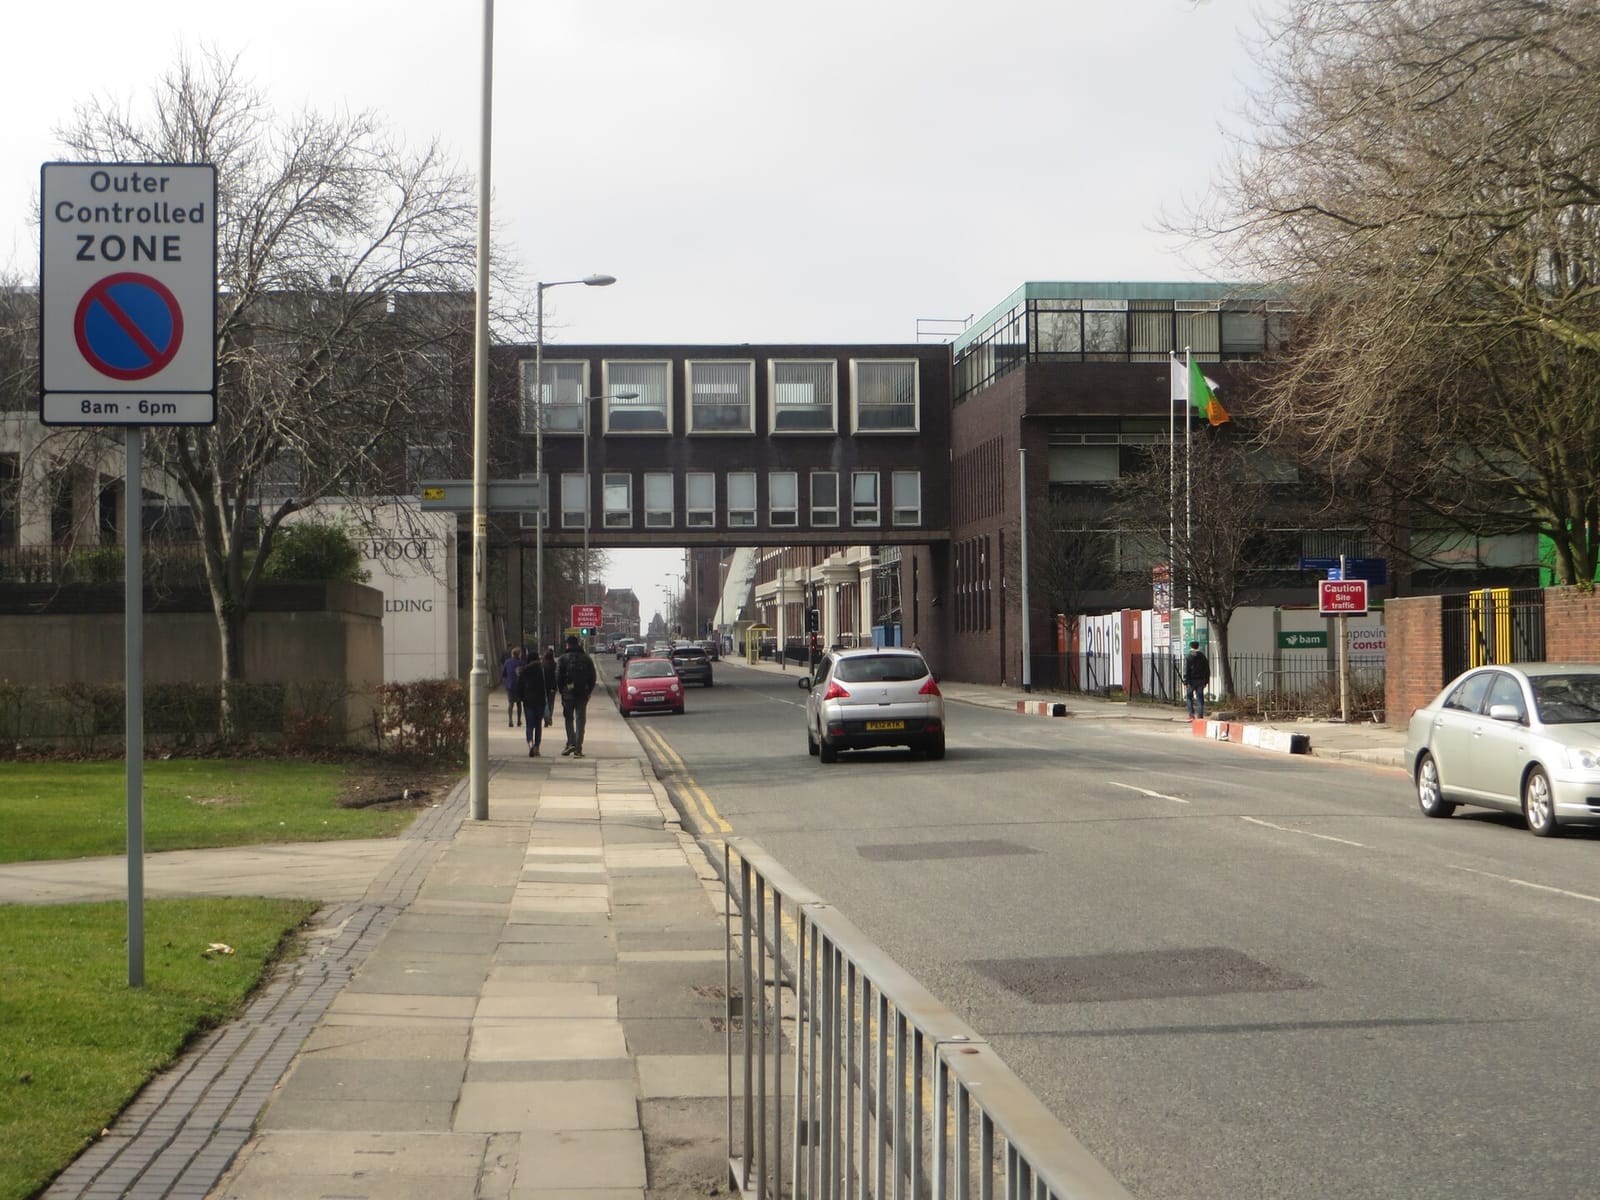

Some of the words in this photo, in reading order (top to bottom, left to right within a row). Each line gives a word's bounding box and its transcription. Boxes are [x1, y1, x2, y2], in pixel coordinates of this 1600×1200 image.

[90, 171, 170, 193] Outer
[55, 201, 204, 223] Controlled
[76, 235, 182, 262] ZONE
[81, 400, 119, 414] 8am
[138, 400, 177, 416] 6pm
[358, 541, 434, 560] RPOOL
[1324, 584, 1362, 593] Caution
[385, 599, 433, 612] LDING
[1086, 622, 1120, 657] 2016
[1299, 635, 1320, 644] bam
